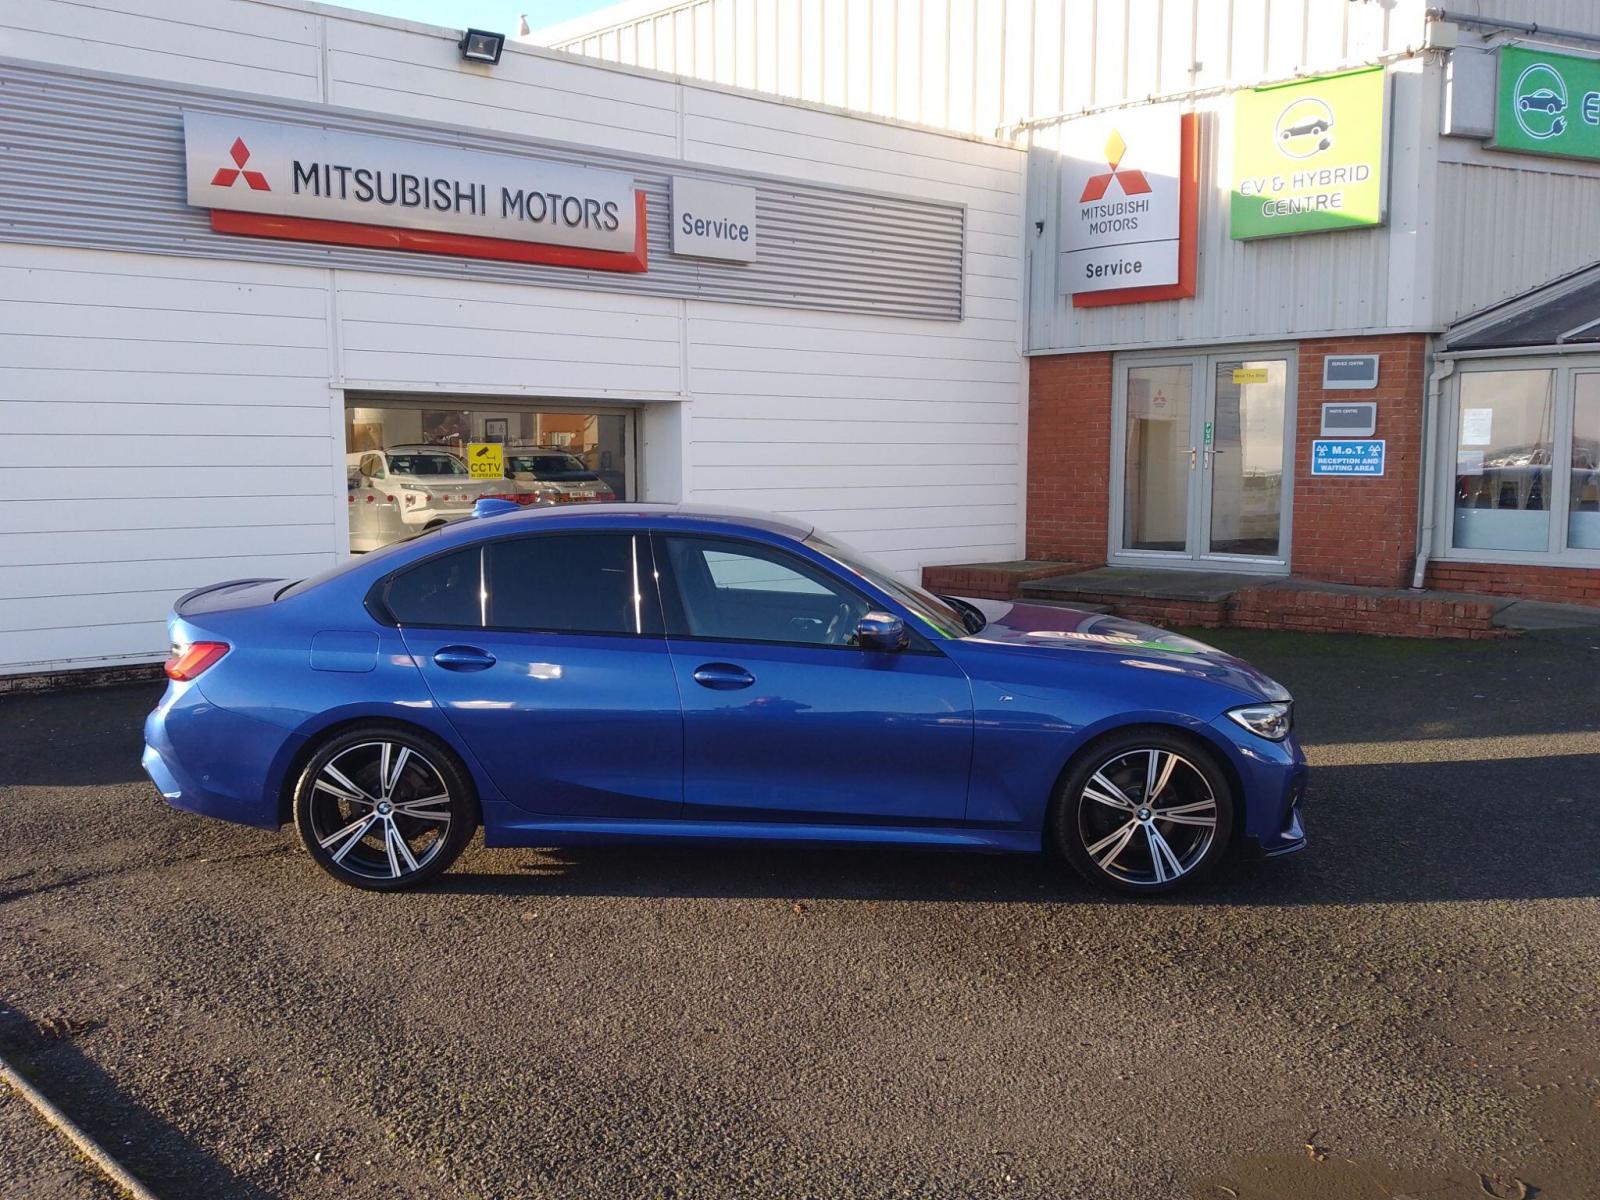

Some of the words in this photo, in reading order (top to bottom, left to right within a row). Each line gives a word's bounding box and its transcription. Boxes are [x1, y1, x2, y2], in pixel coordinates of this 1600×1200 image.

[1240, 179, 1266, 196] EV
[1272, 176, 1285, 192] &
[1293, 165, 1369, 189] HYBRID
[293, 160, 486, 216] MITSUBISHI
[501, 187, 620, 232] MOTORS
[1263, 193, 1342, 217] CENTRE
[1081, 200, 1149, 221] MITSUBISHI
[682, 212, 749, 242] Service
[1090, 217, 1138, 235] MOTORS
[1086, 259, 1142, 278] Service
[1331, 446, 1365, 455] M.o.T.
[470, 463, 501, 472] CCTV
